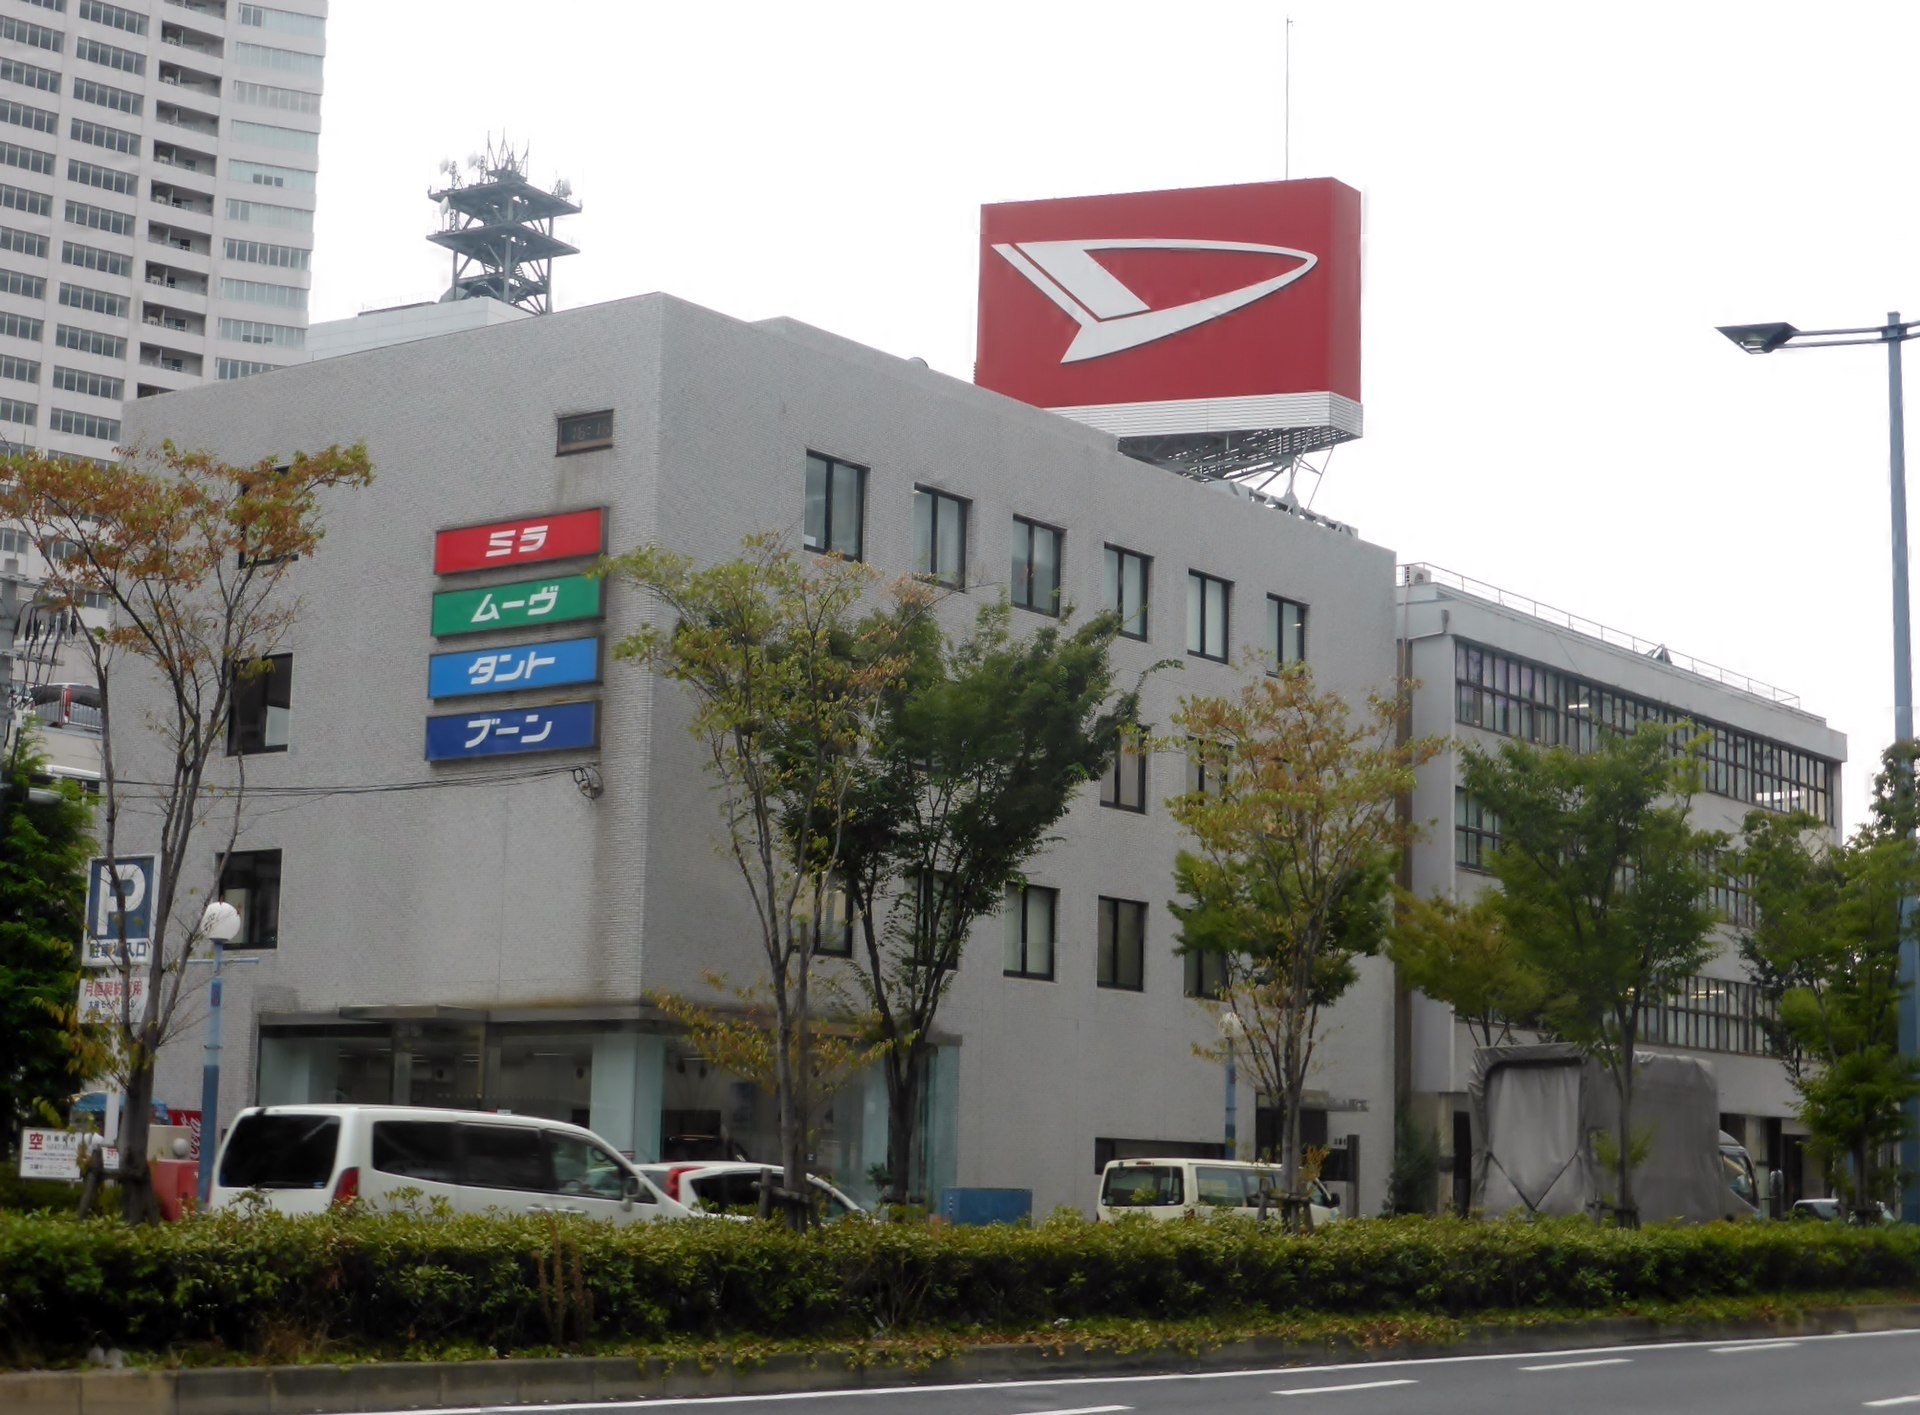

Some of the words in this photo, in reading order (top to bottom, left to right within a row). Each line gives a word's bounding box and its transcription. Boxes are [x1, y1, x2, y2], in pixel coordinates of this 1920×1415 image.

[485, 525, 549, 558] ミラ
[470, 585, 560, 624] ムーヴ
[468, 651, 556, 685] タント
[464, 714, 553, 749] ブーン
[97, 864, 146, 936] P
[29, 1132, 44, 1151] 空
